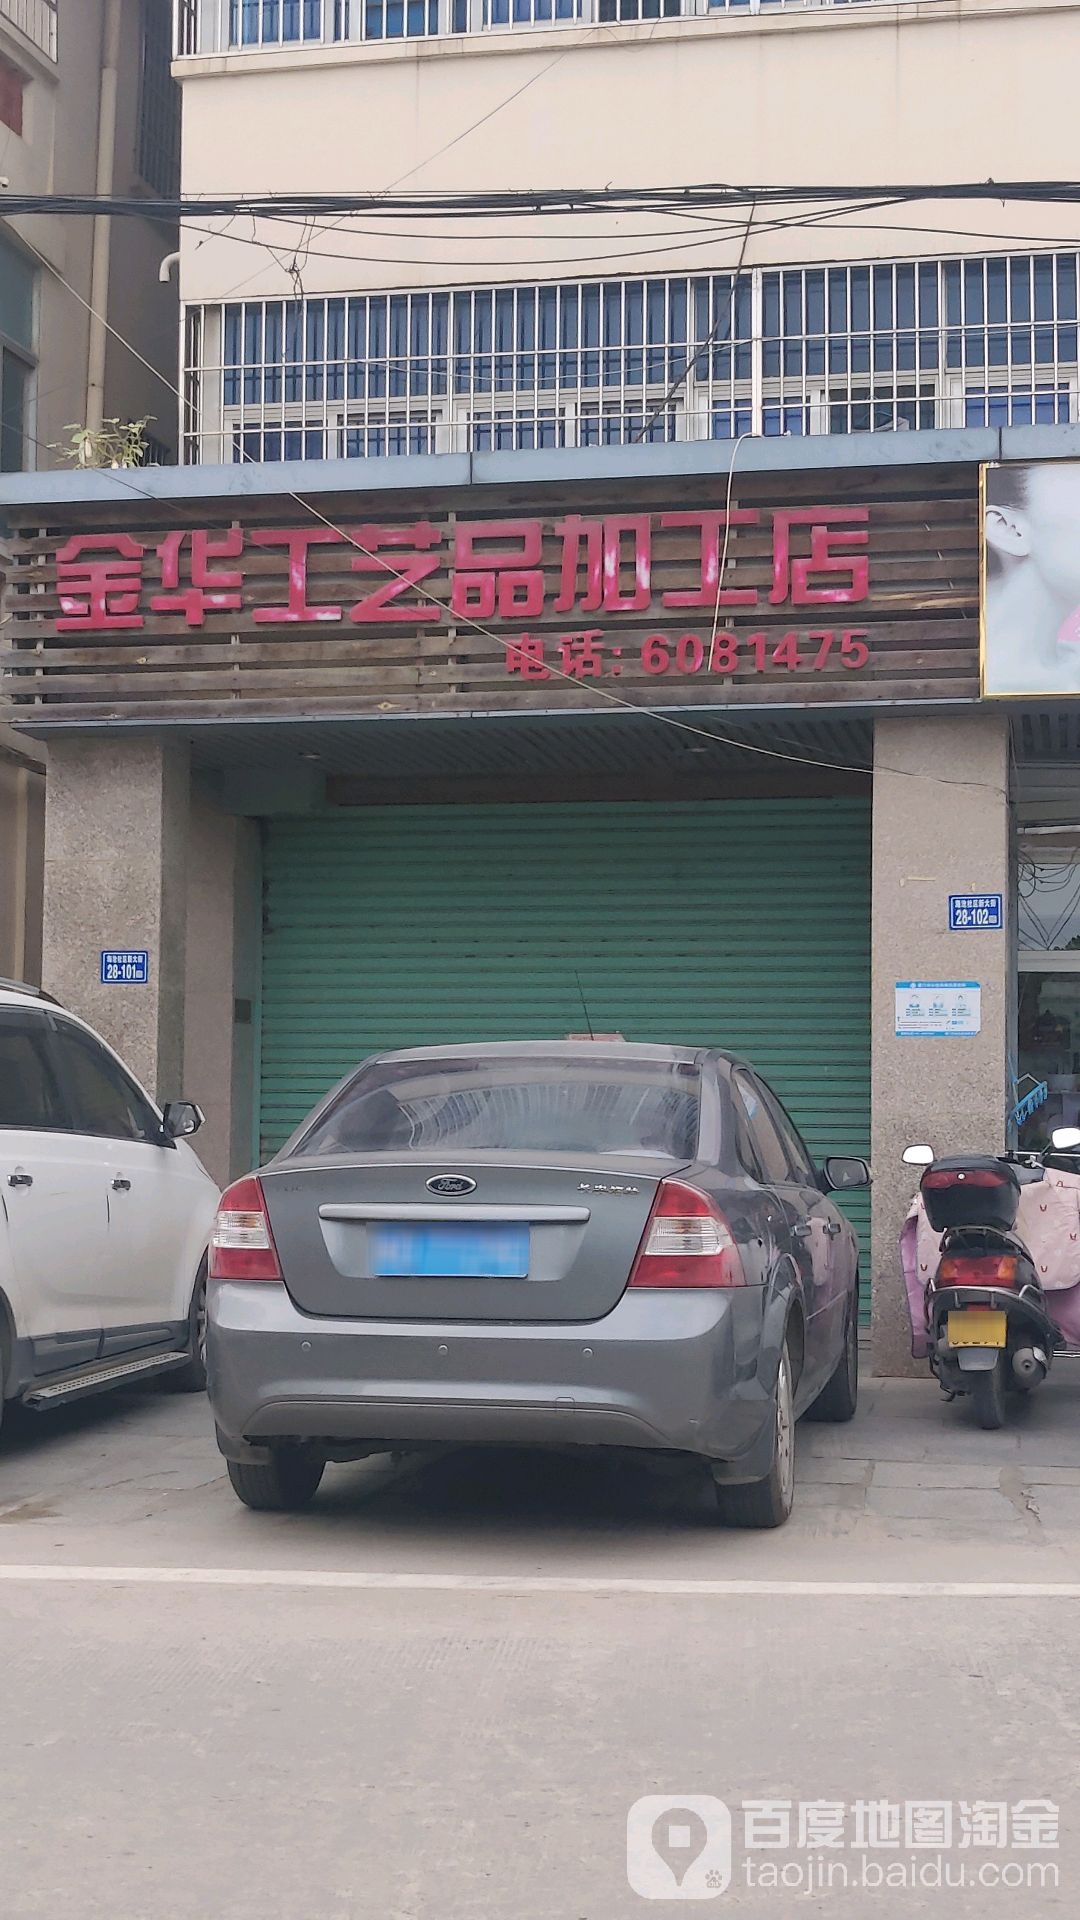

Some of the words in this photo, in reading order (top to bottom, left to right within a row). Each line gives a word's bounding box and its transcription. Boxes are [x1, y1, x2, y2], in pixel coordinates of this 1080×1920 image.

[56, 508, 870, 632] 金华工艺品加工店
